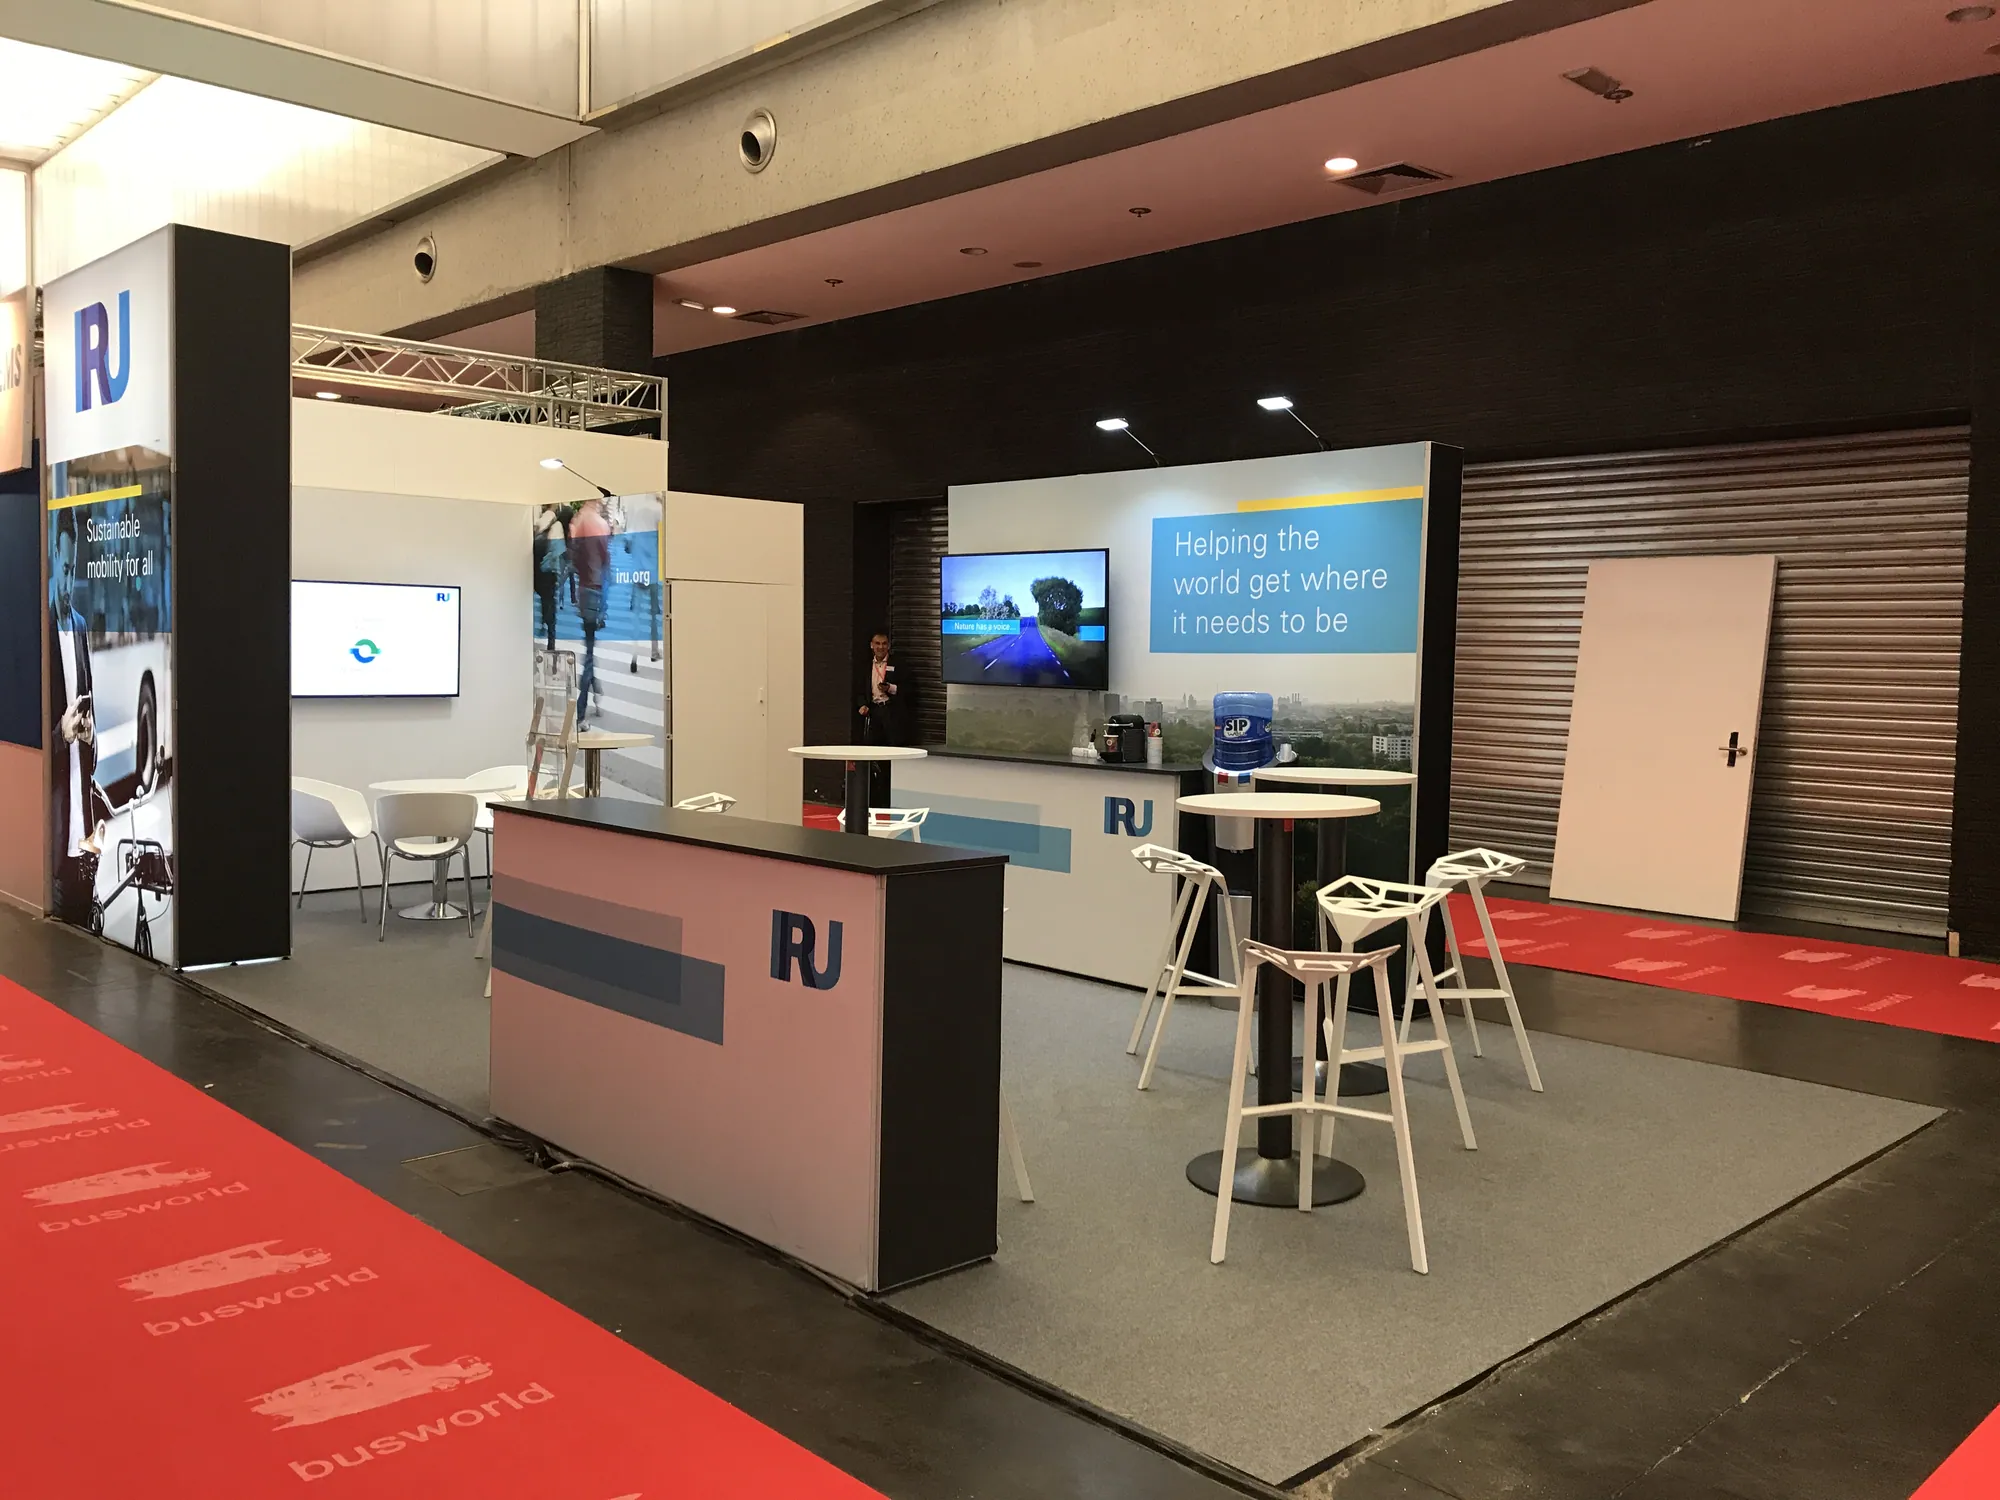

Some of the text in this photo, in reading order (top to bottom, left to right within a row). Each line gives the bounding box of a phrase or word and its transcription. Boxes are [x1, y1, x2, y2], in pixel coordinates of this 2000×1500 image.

[86, 513, 140, 542] Sustainable
[1175, 524, 1320, 561] Helping the
[87, 549, 153, 583] mobility for all
[616, 567, 650, 586] iru.org
[1173, 564, 1388, 600] world get where
[954, 622, 974, 631] Nature
[976, 622, 987, 631] has
[1173, 606, 1348, 634] it needs to be
[1226, 719, 1248, 732] SIP
[37, 1181, 250, 1234] busworld
[143, 1266, 379, 1337] busworld
[287, 1382, 555, 1482] busworld
